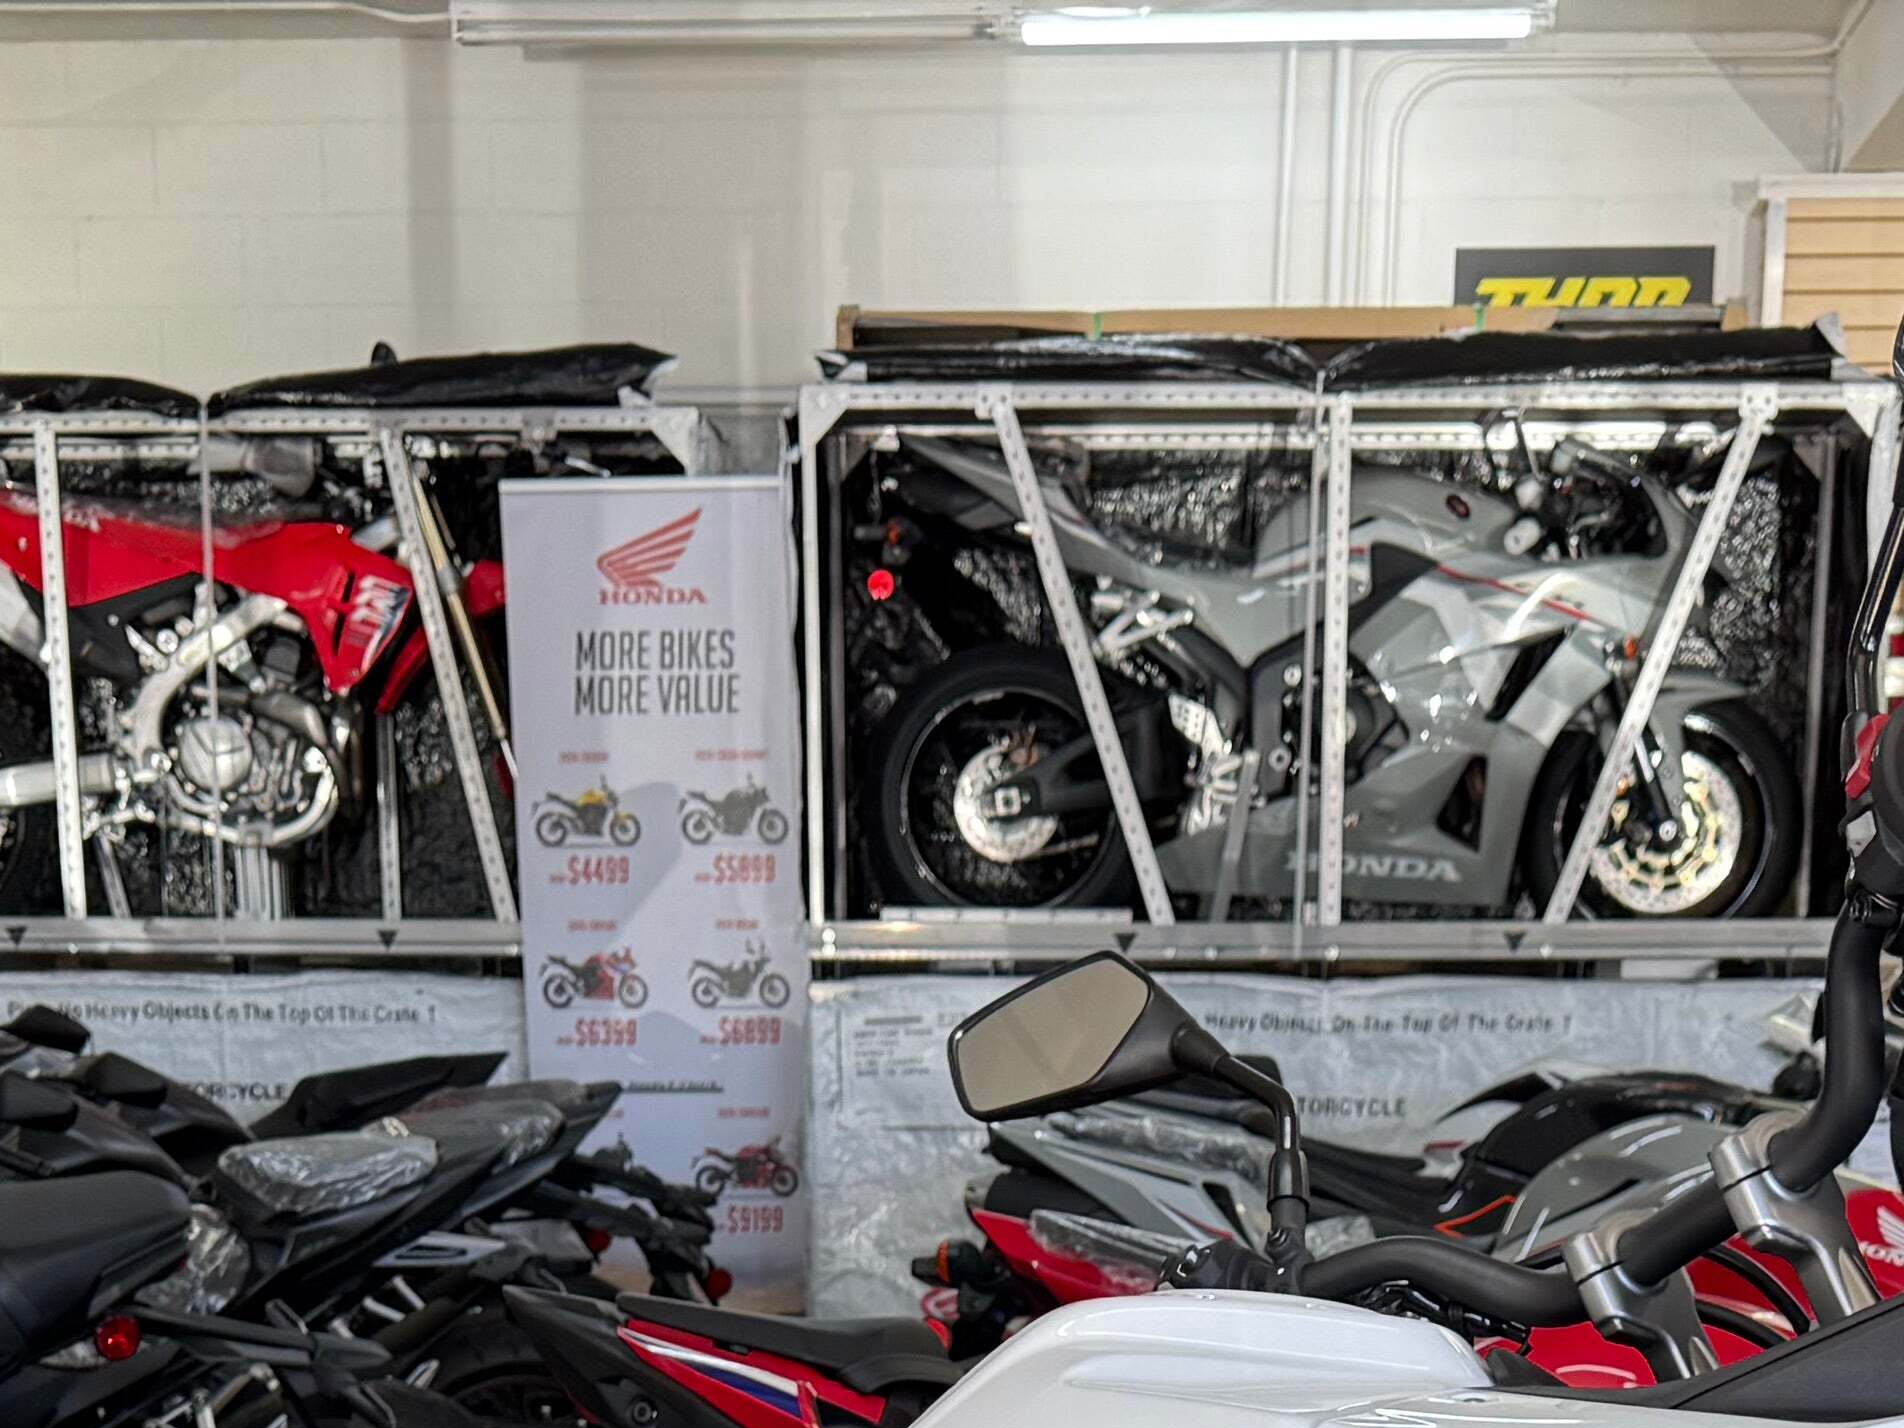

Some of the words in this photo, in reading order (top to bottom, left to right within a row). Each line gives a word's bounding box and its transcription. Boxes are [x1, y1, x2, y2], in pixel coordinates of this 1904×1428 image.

[599, 586, 709, 605] HONDA
[576, 630, 651, 671] MORE
[659, 629, 736, 670] BIKES
[574, 675, 649, 716] MORE
[656, 673, 741, 714] VALUE
[195, 1081, 286, 1101] ORCYCLE
[1297, 1096, 1407, 1117] TORCYCLE
